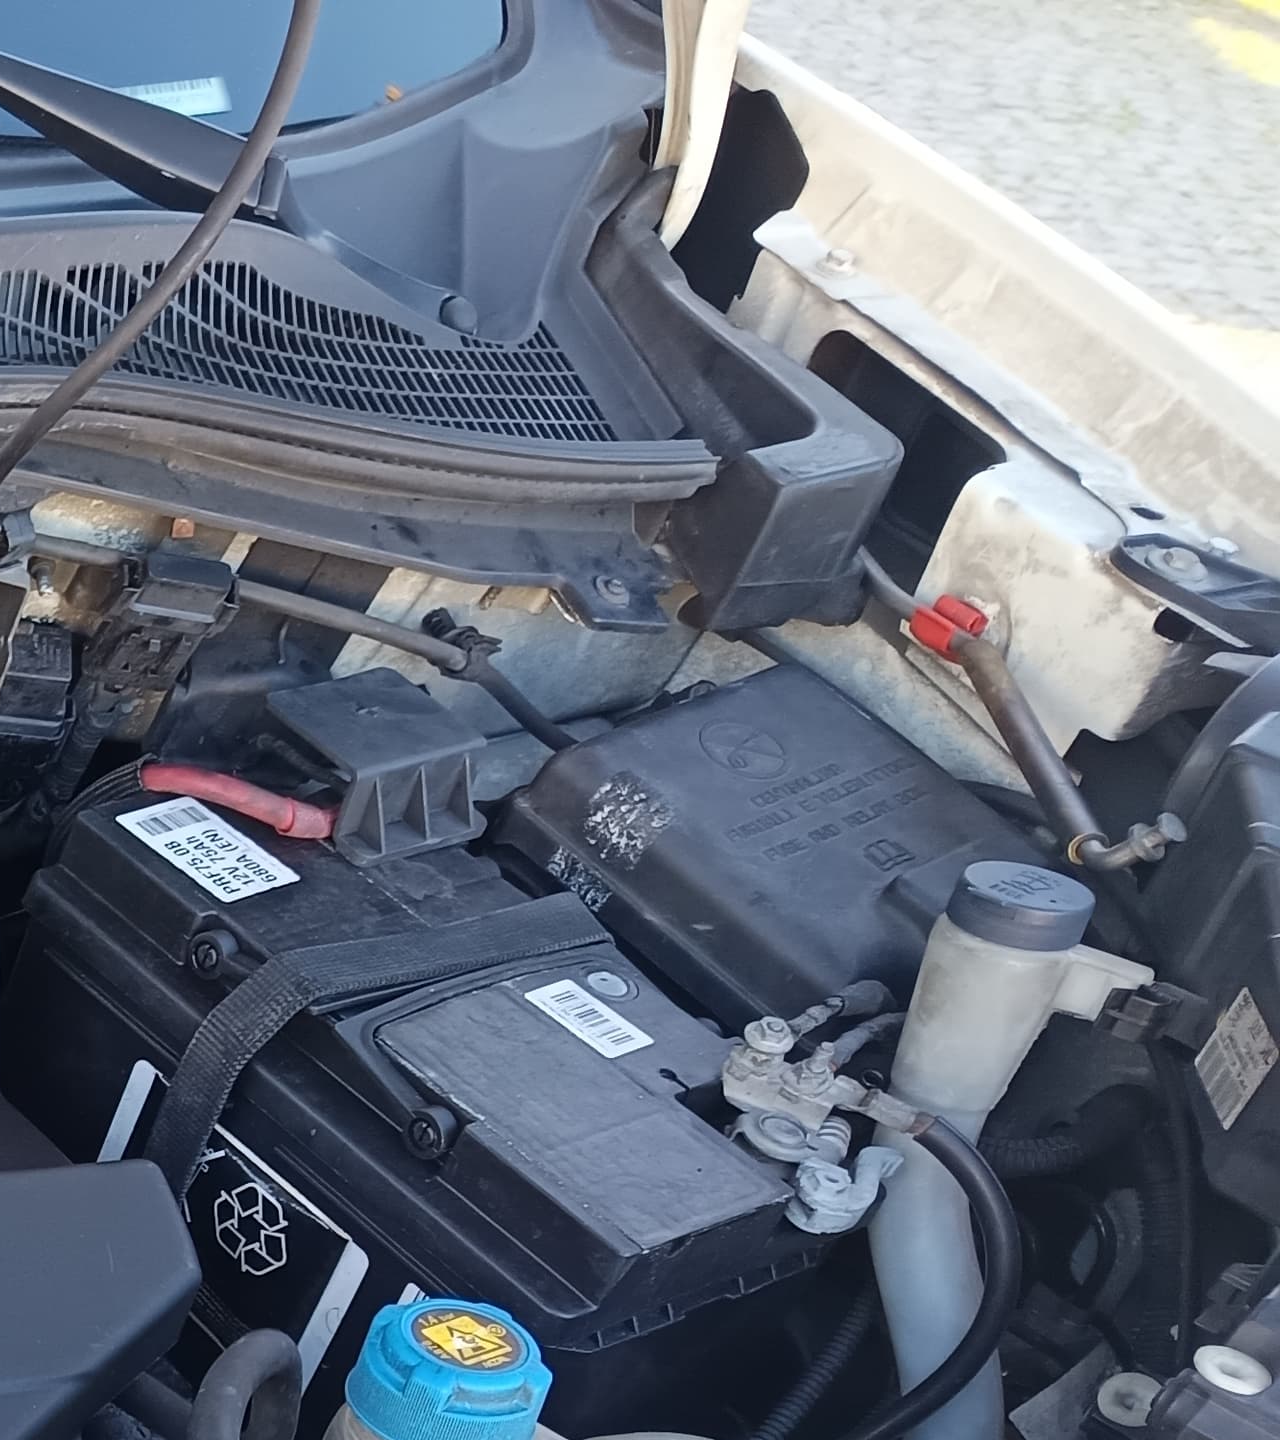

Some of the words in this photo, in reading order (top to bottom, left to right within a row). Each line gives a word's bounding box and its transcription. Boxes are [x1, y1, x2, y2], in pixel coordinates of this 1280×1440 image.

[186, 835, 223, 864] 75Ah
[201, 828, 239, 852] (EN)
[222, 865, 256, 886] 12V
[236, 854, 278, 883] 680A
